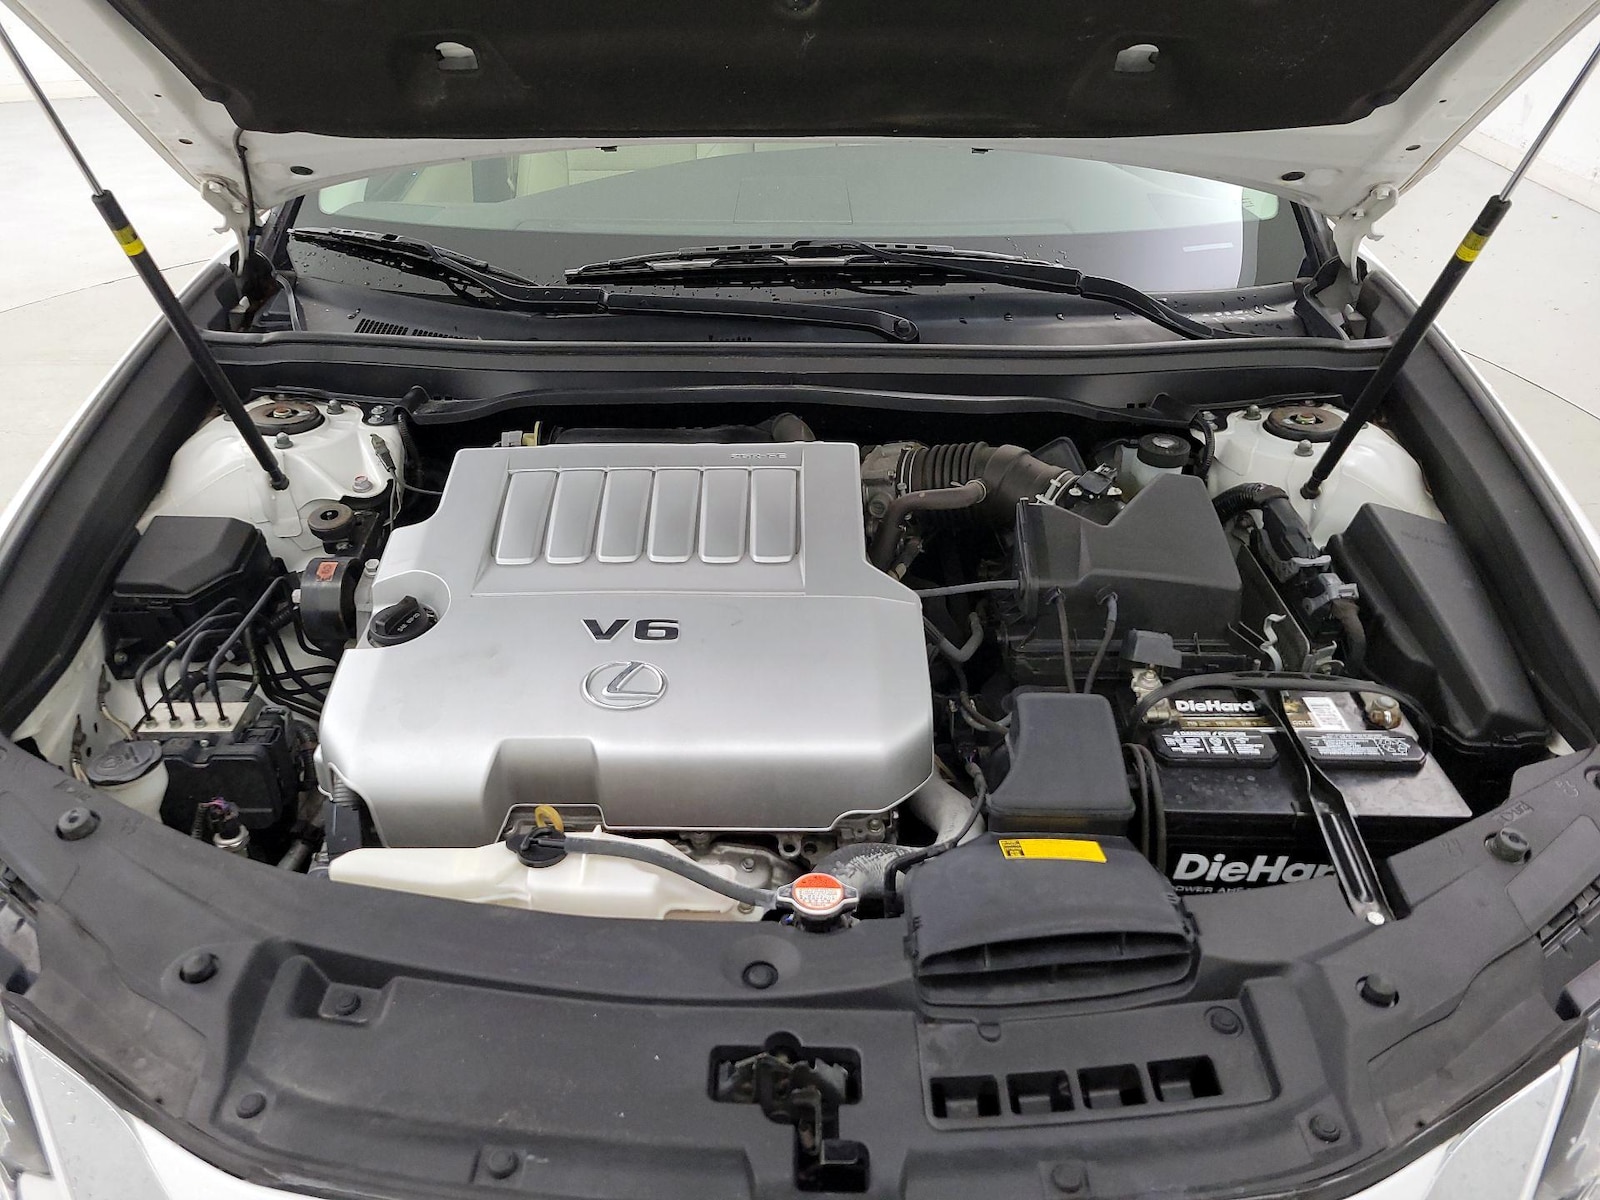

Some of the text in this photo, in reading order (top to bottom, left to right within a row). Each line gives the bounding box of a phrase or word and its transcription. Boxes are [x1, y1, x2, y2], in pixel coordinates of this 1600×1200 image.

[581, 618, 679, 642] V6
[1175, 700, 1256, 713] DieHard
[1173, 853, 1336, 883] DieHar
[1175, 885, 1213, 894] OWER
